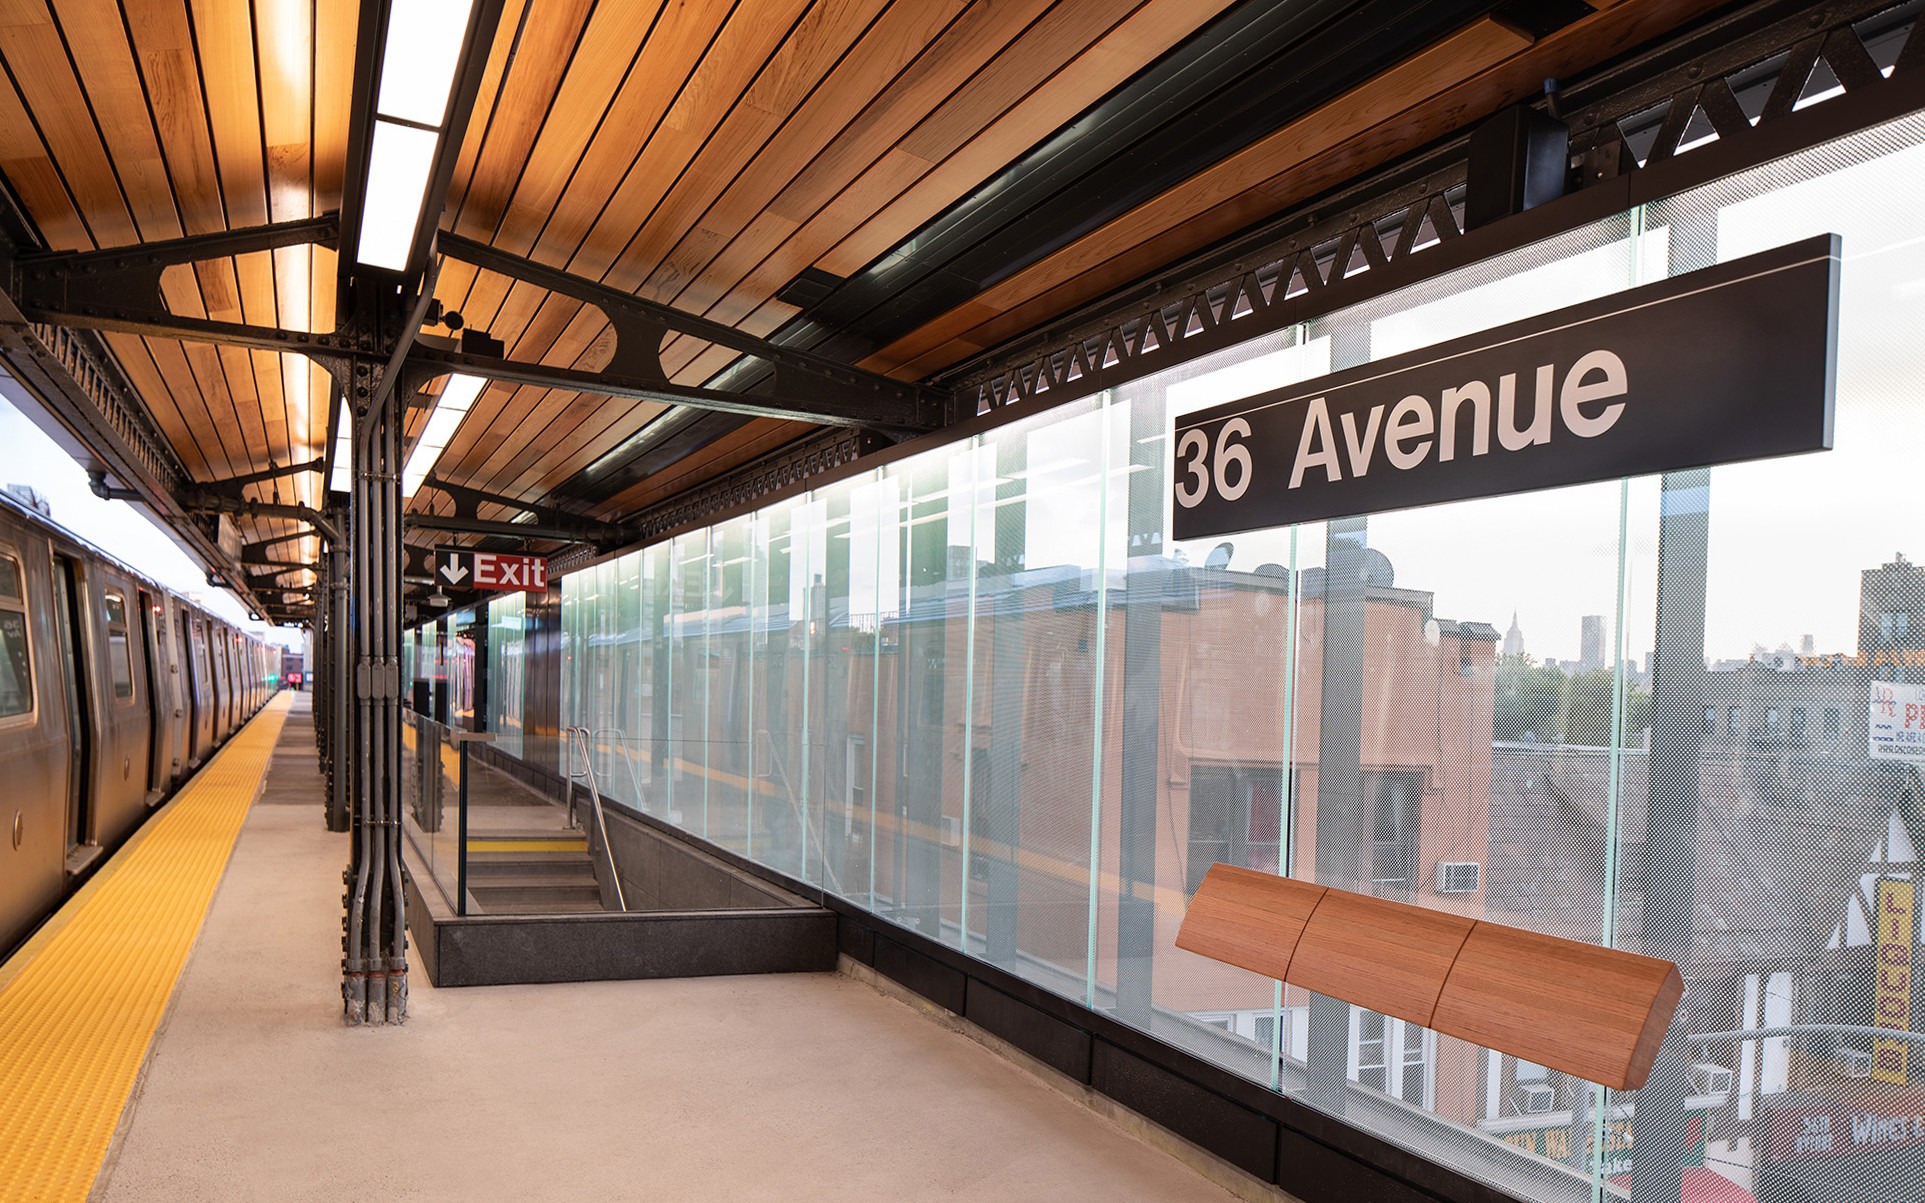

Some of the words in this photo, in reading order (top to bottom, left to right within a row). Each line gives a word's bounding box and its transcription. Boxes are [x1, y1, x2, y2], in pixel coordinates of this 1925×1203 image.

[1174, 417, 1253, 509] 36
[1287, 349, 1629, 490] Avenue
[474, 553, 545, 588] Exit
